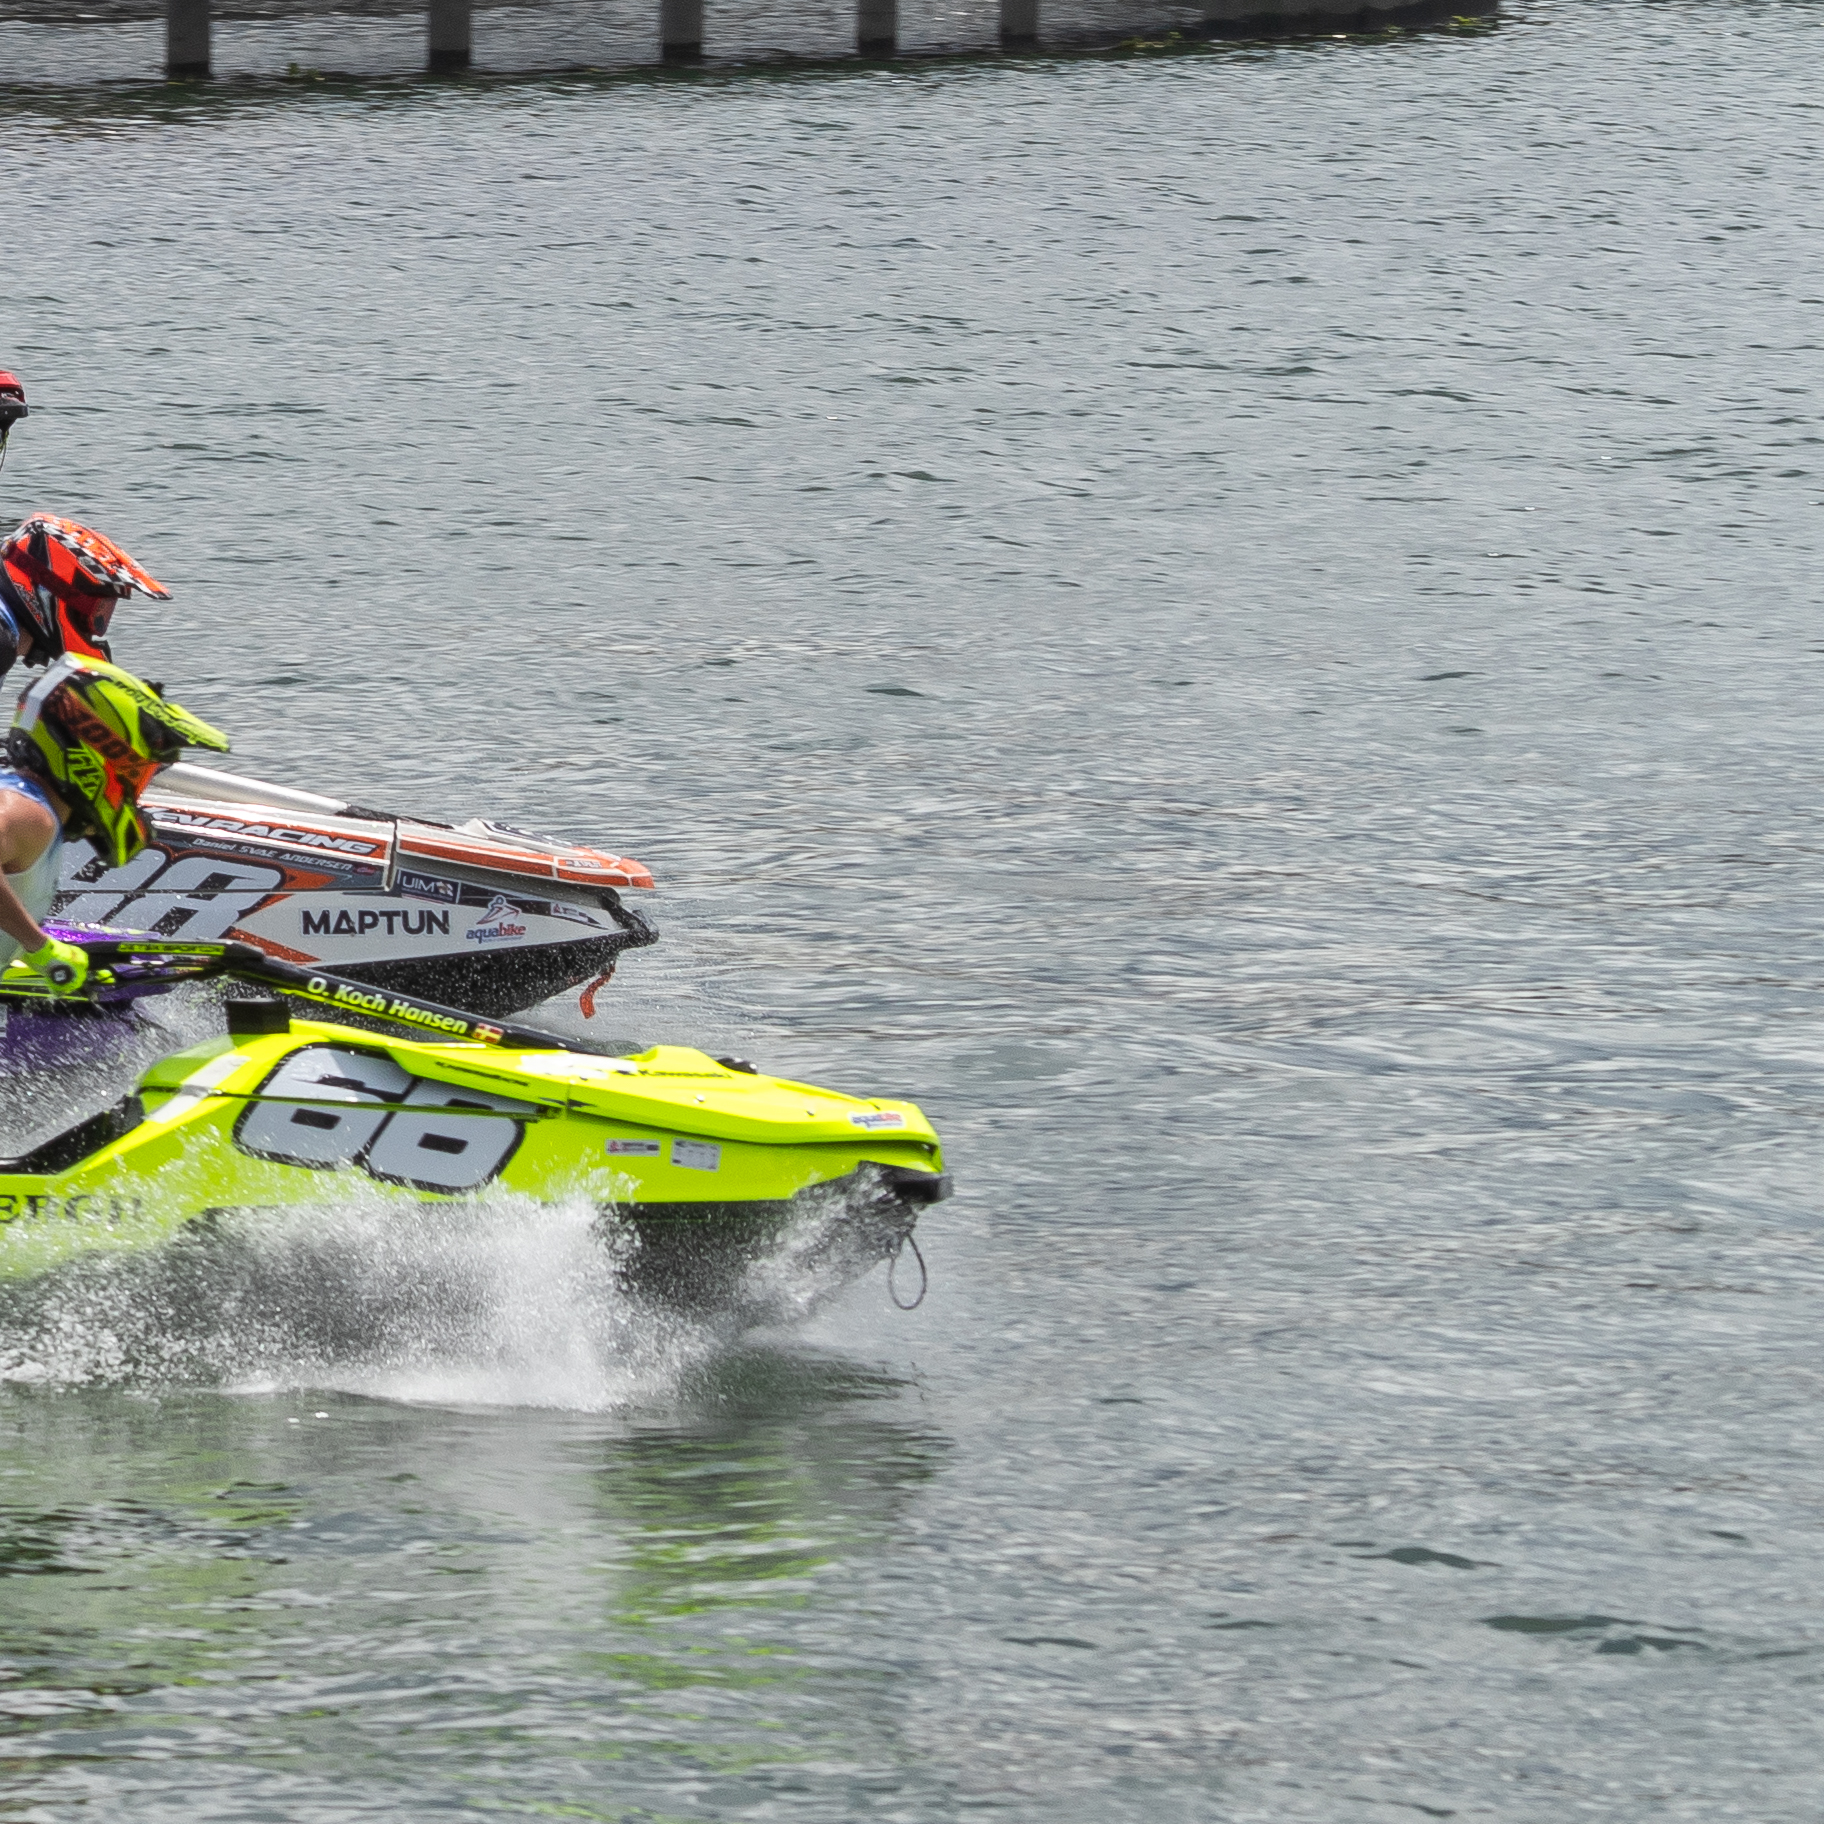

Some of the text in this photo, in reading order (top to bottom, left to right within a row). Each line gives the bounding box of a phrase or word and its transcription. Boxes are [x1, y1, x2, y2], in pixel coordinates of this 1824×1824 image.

[192, 836, 237, 853] Daniel
[280, 853, 354, 873] ANDERSEN
[402, 875, 435, 893] UIM
[302, 908, 450, 936] MAPTUN
[465, 922, 527, 944] aquabike
[306, 977, 468, 1034] O. Koch Hansen
